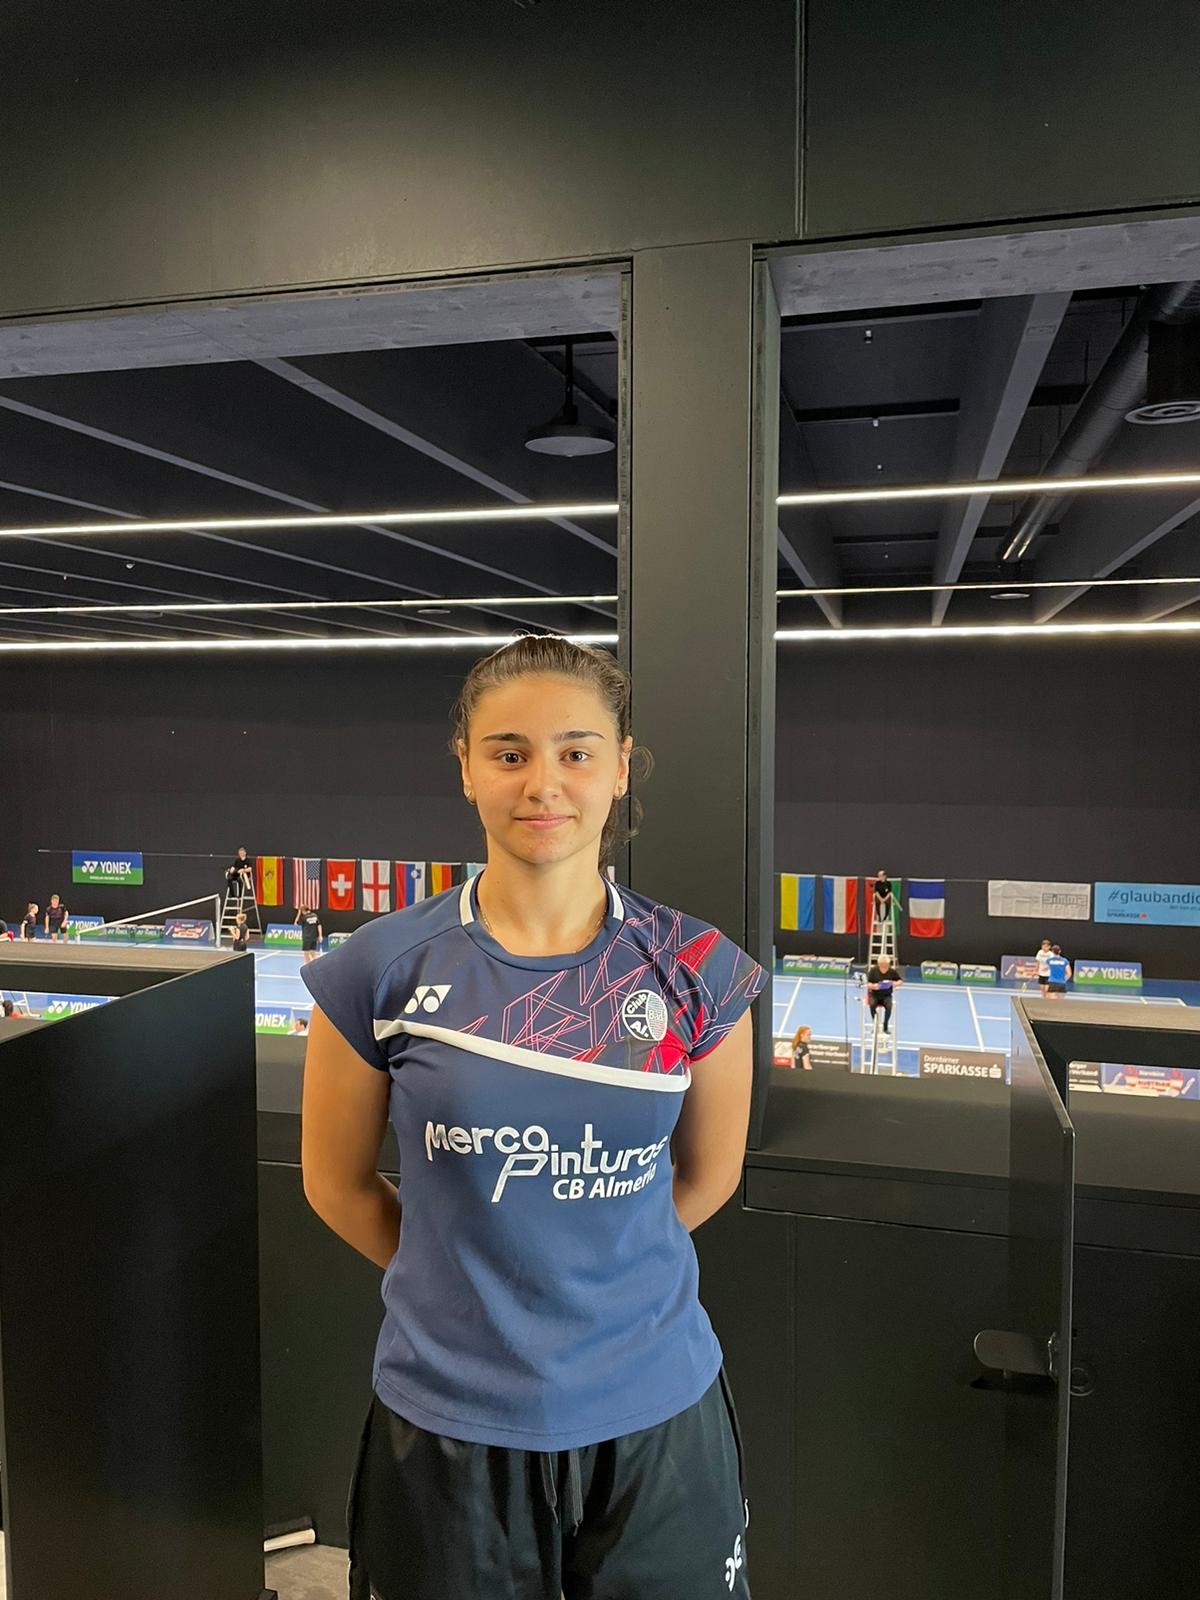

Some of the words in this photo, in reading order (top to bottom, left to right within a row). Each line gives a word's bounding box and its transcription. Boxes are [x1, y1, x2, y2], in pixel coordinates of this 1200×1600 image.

[100, 861, 131, 874] YONEX
[1101, 967, 1138, 980] YONEX
[626, 993, 647, 1014] Club
[255, 1013, 287, 1027] ONEX
[923, 1062, 988, 1077] SPARKASSE
[425, 1120, 549, 1161] Merca
[491, 1123, 669, 1203] Pinturas
[553, 1178, 585, 1199] CB
